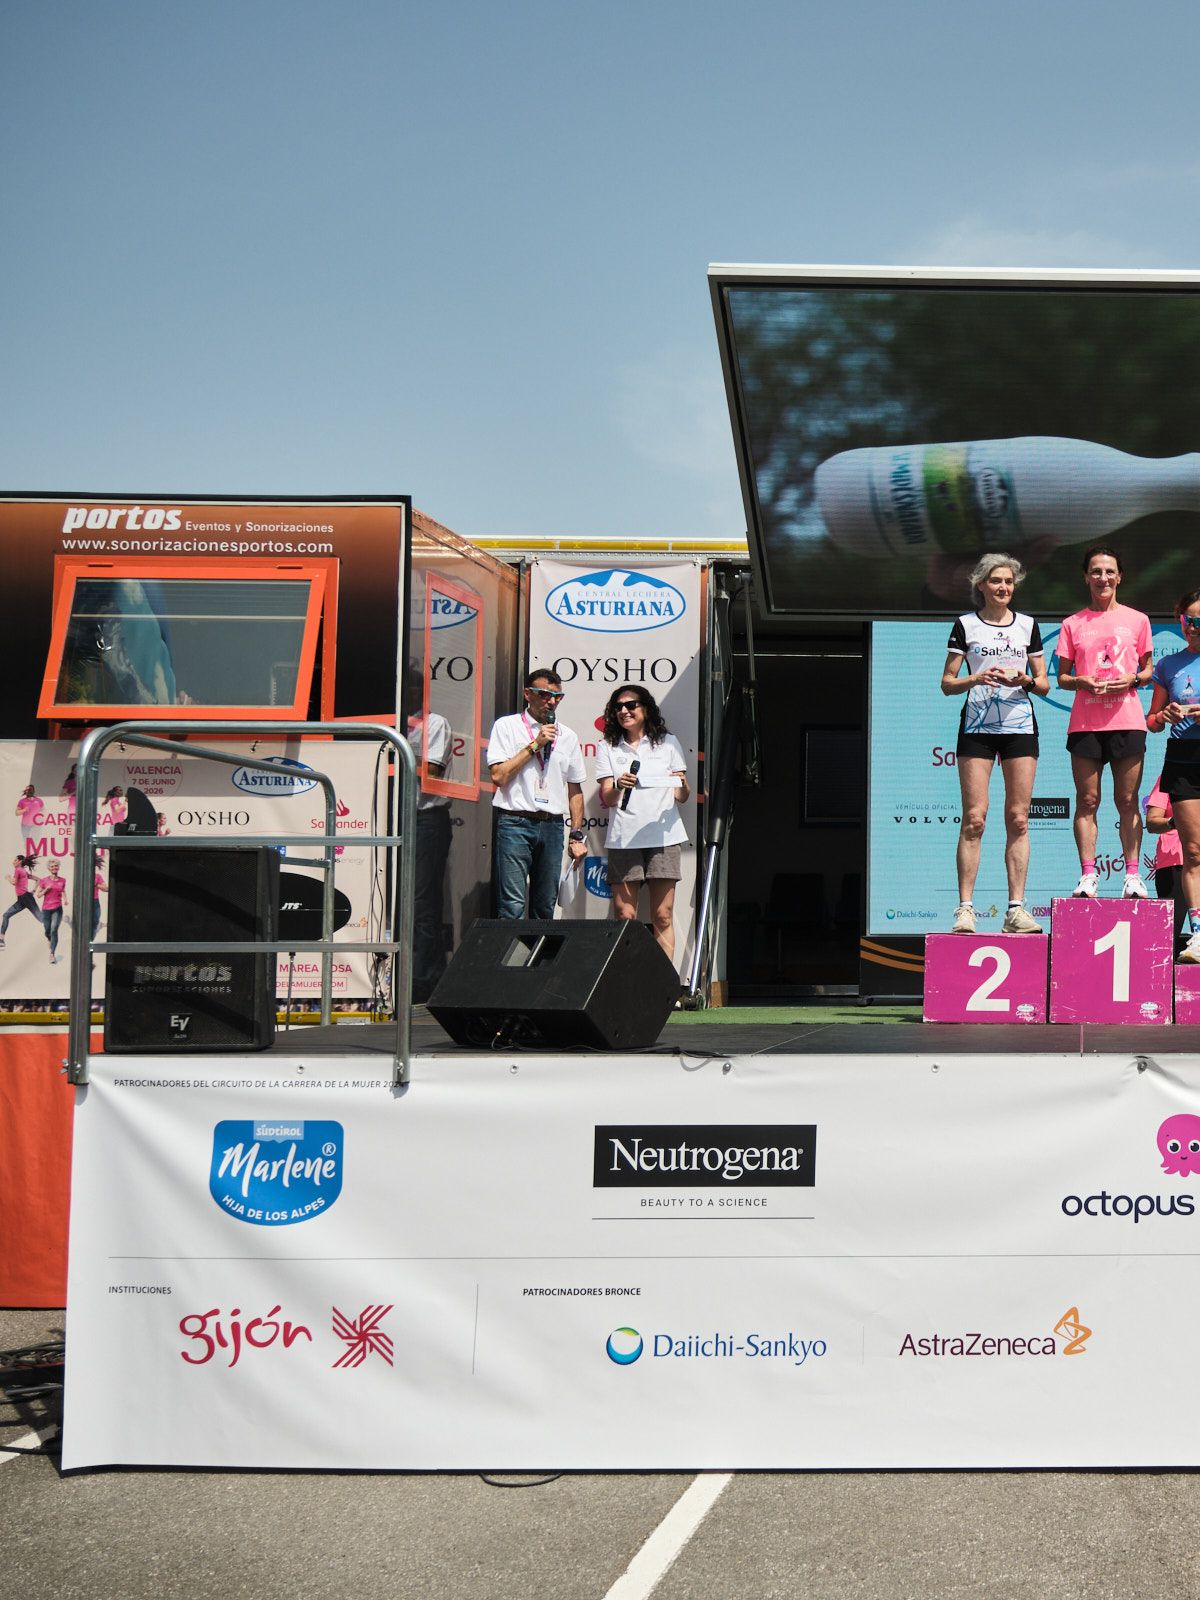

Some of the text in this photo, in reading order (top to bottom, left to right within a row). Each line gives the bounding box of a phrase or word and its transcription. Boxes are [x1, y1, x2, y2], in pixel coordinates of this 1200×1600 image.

[62, 506, 334, 534] portos Eventos y Sonorizaciones
[62, 537, 334, 554] www.sonorizacionesportos.com
[555, 592, 675, 616] ASTURIANA
[552, 657, 677, 682] OYSHO
[126, 766, 182, 775] VALENCIA
[132, 778, 176, 786] 7 DE JUNIO
[143, 787, 163, 795] 2026
[33, 813, 114, 827] CARRRA
[177, 810, 250, 826] OYSHO
[311, 818, 368, 829] Saander
[894, 816, 961, 824] VOLVO
[282, 902, 300, 910] JTS
[280, 964, 353, 973] MAREA OSA
[1094, 921, 1131, 1002] 1
[965, 945, 1011, 1012] 2
[114, 1079, 191, 1088] PATROCINADORES
[193, 1080, 209, 1088] DEL
[211, 1080, 252, 1088] CIRCUITO
[609, 1138, 802, 1180] Neutrogena
[222, 1194, 326, 1221] HIJA DE LOS ALPES
[640, 1198, 768, 1207] BEAUTY TO A SCIENCE
[108, 1285, 172, 1295] INSTITUCIONES
[522, 1287, 642, 1297] PATROCINADORES BRONCE
[179, 1304, 313, 1368] gijón
[653, 1332, 827, 1366] Daiichi-Sankyo
[898, 1333, 1056, 1356] AstraZeneca
